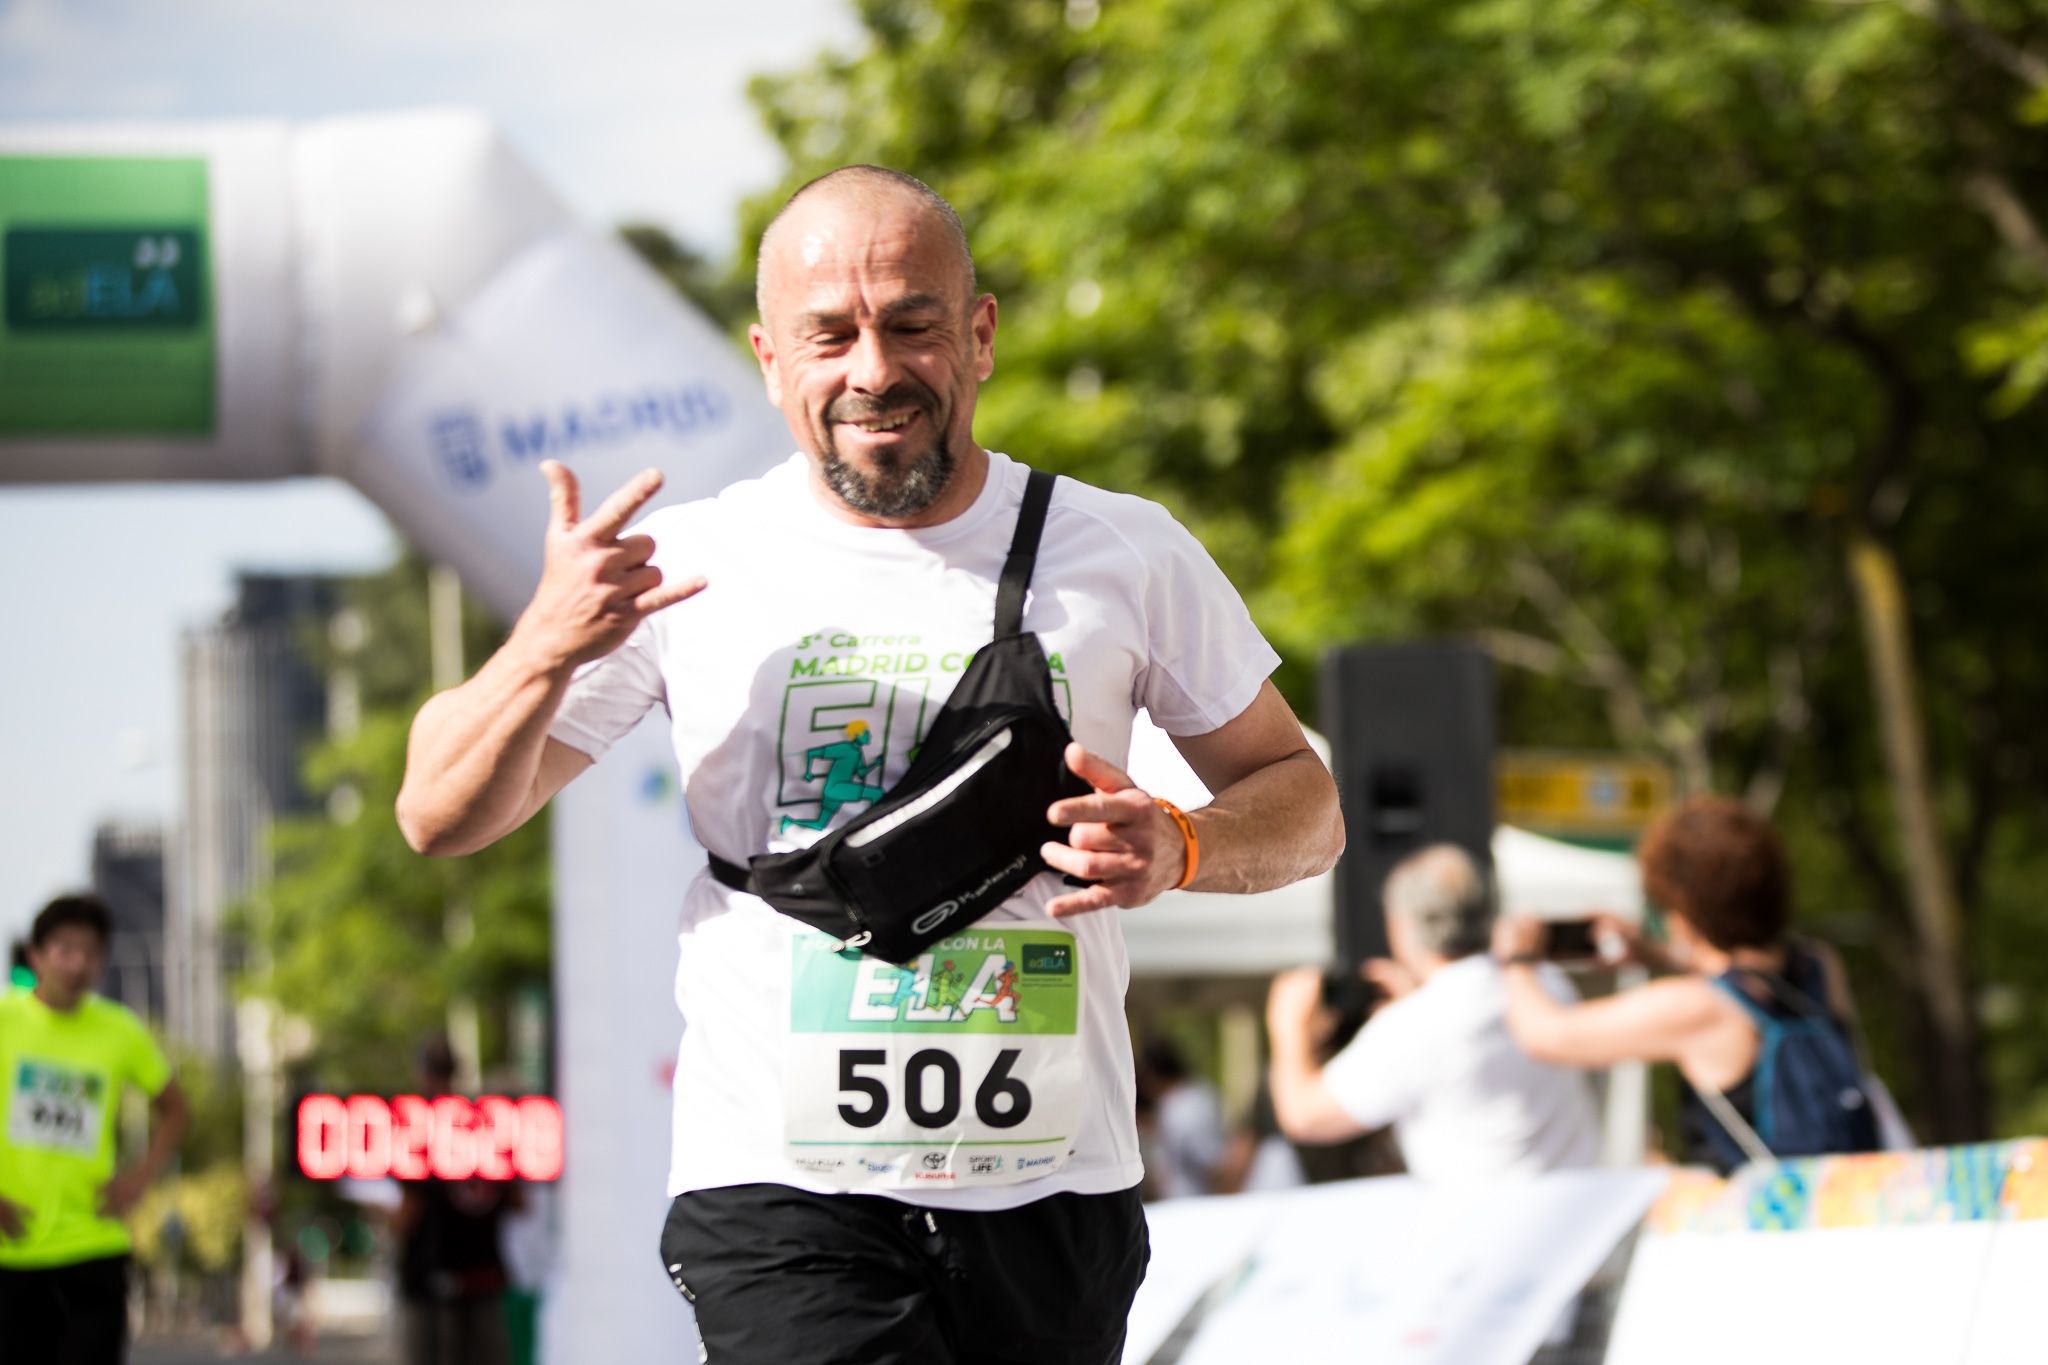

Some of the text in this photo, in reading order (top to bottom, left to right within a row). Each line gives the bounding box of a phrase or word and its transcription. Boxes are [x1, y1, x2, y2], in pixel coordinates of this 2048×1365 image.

[829, 633, 922, 648] Carrera
[790, 651, 930, 679] MADRID
[940, 936, 1006, 951] CON LA
[848, 953, 1018, 1022] ELA
[837, 1048, 1032, 1129] 506
